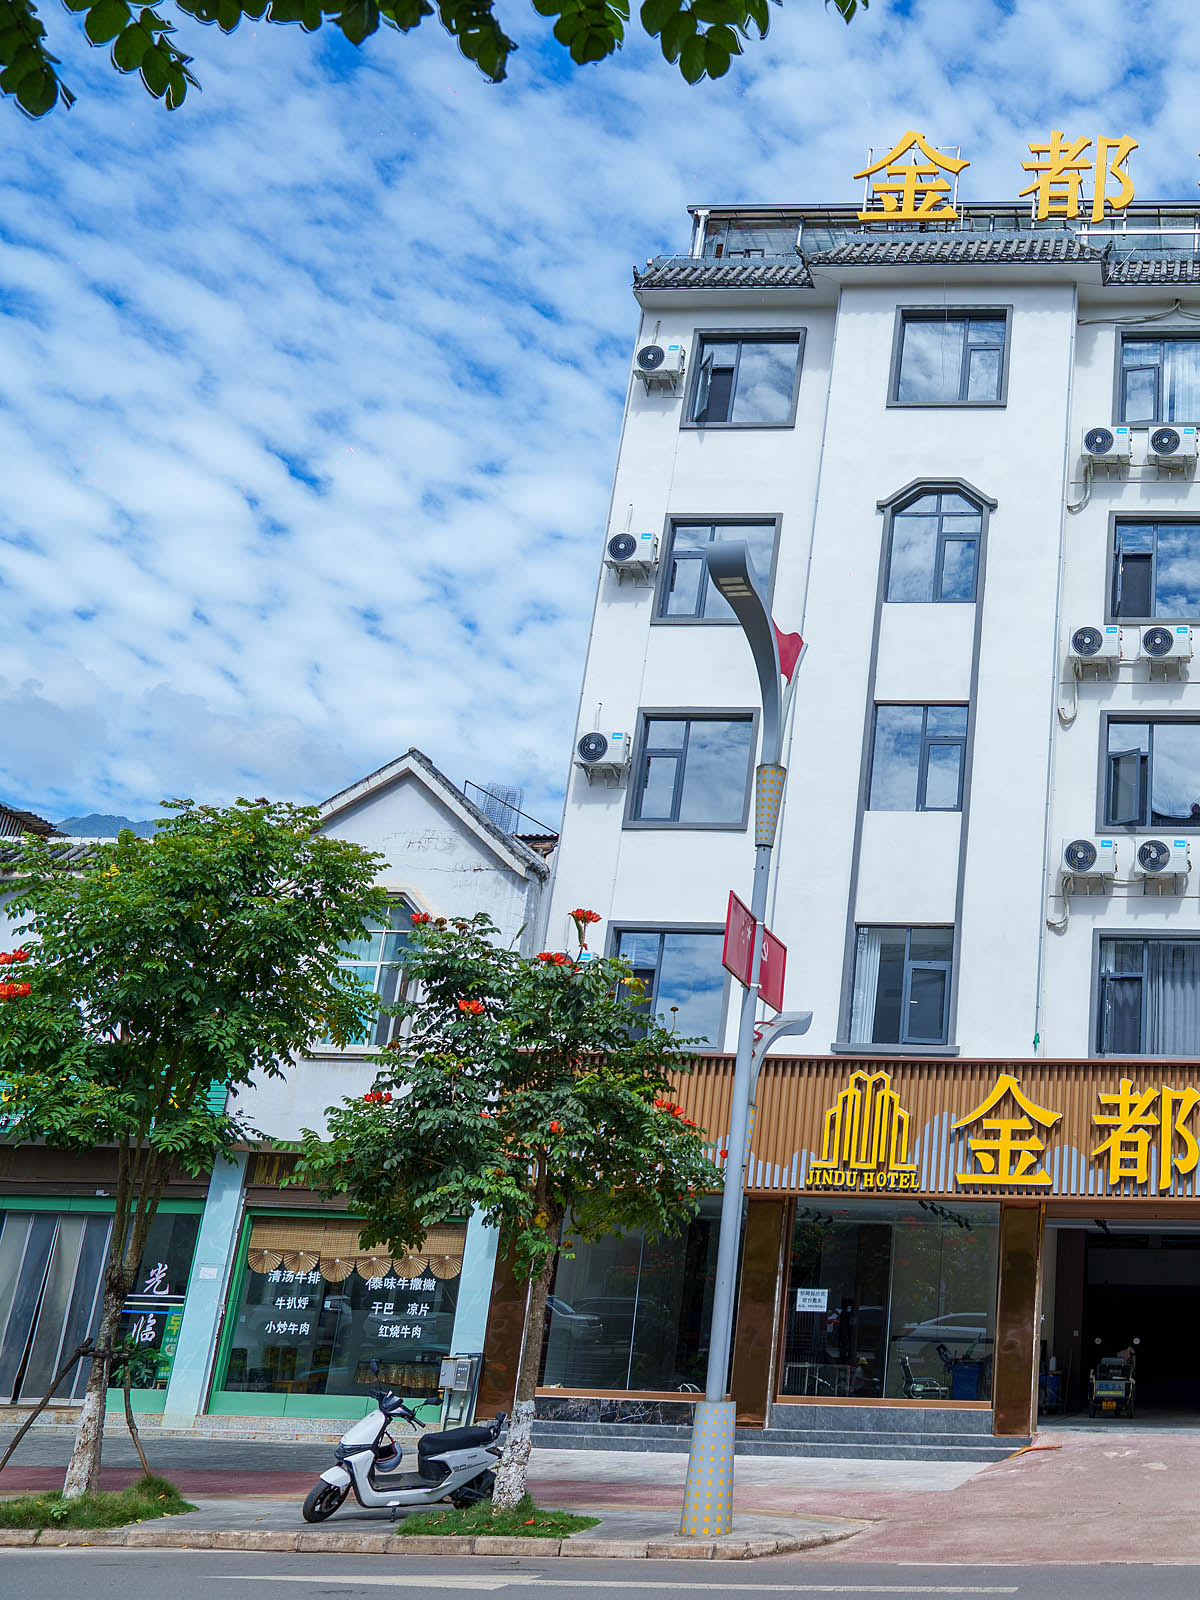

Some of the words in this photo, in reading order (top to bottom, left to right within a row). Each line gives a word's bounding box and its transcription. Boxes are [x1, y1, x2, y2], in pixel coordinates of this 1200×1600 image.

[806, 1169, 858, 1187] JINDU
[863, 1171, 920, 1188] HOTEL
[267, 1269, 322, 1285] 清汤牛排
[264, 1320, 311, 1336] 小炒牛肉
[377, 1324, 422, 1339] 红烧牛肉
